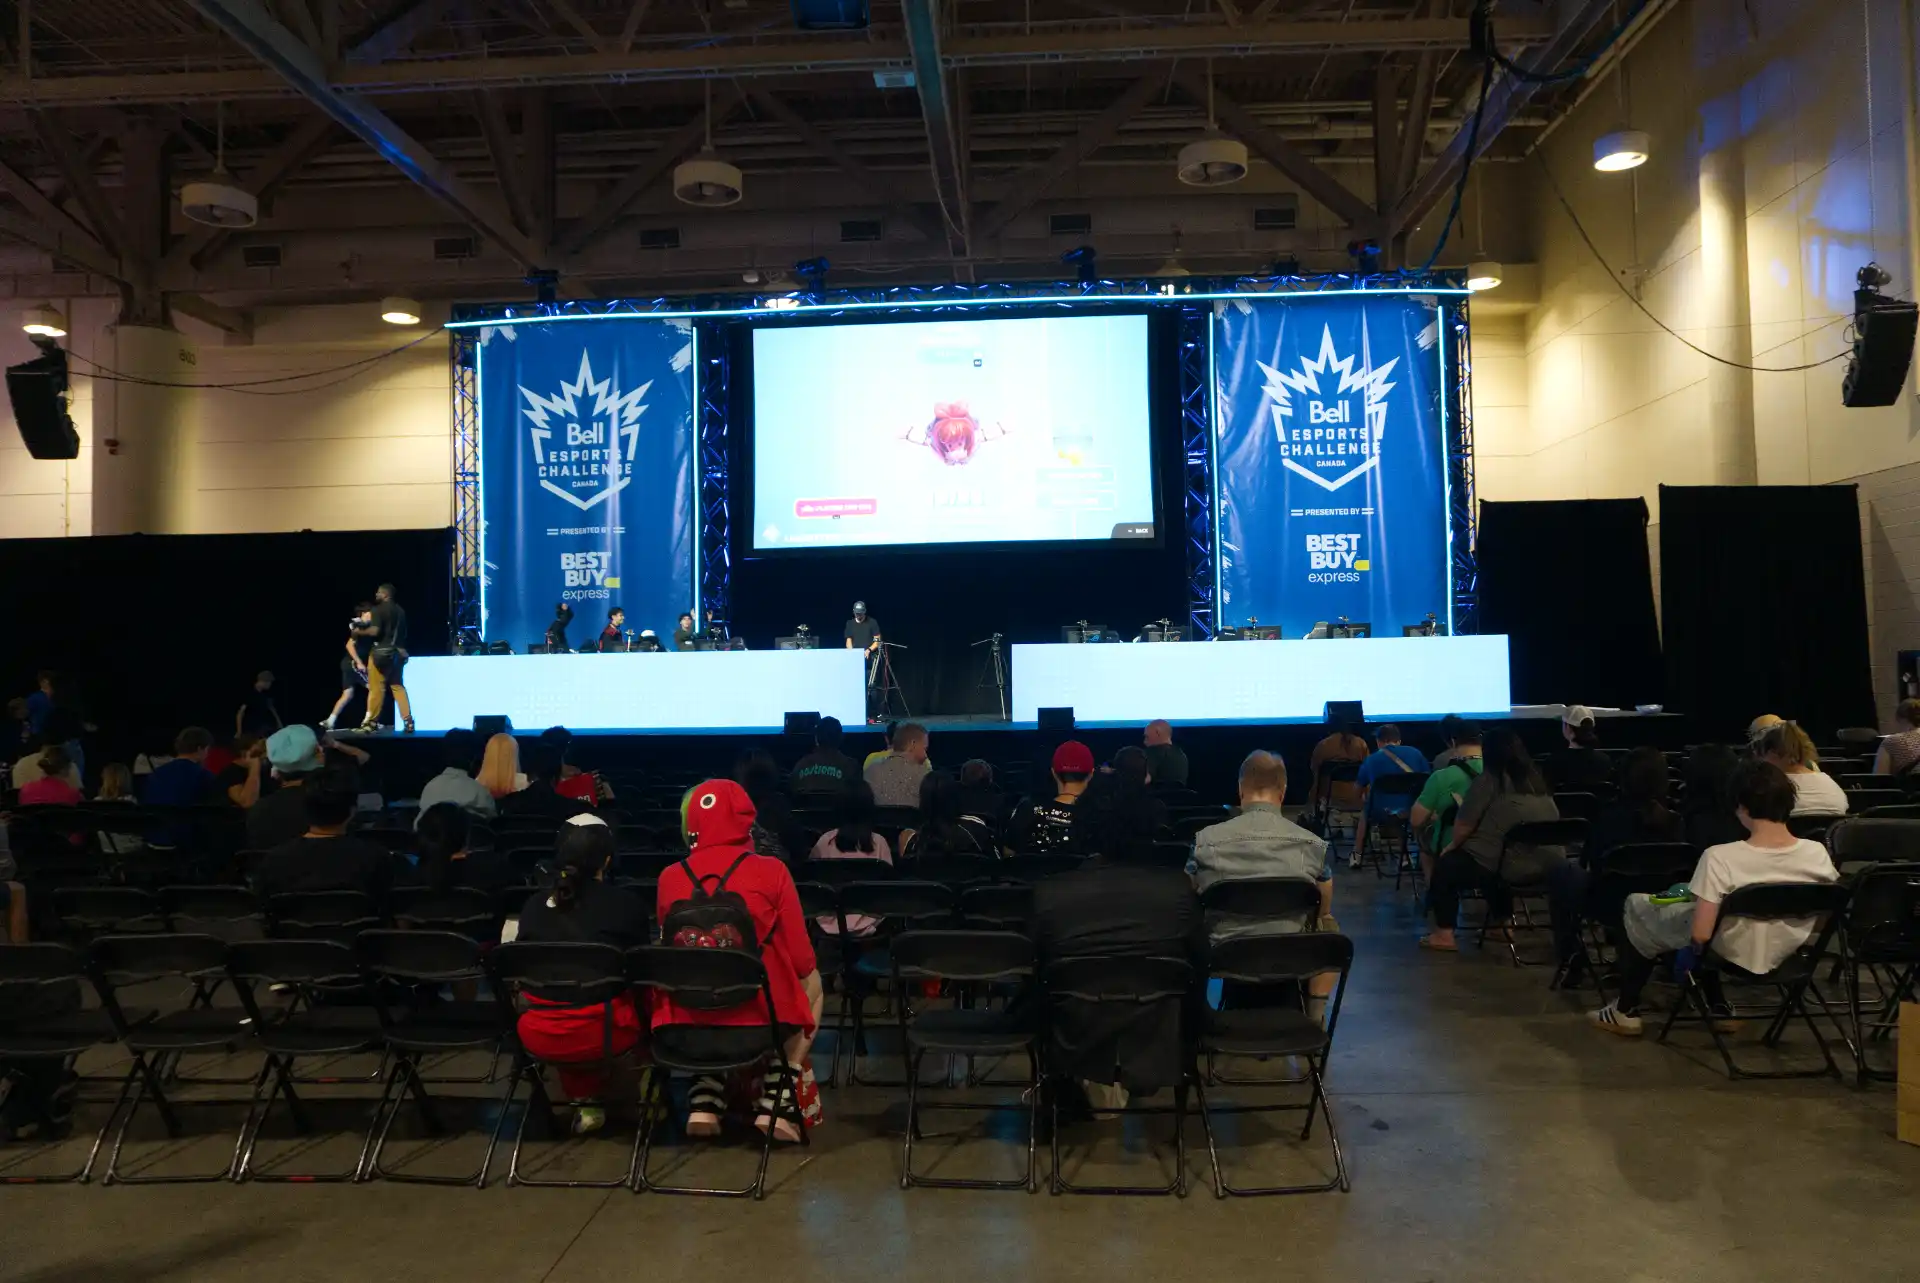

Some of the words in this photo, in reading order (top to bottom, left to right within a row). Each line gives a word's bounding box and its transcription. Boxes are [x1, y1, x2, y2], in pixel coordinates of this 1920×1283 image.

[1309, 400, 1350, 424] Bell
[567, 422, 604, 445] Bell
[1292, 428, 1368, 441] ESPORTS
[549, 449, 622, 462] ESPORTS
[1280, 442, 1381, 456] CHALLENGE
[538, 463, 632, 477] CHALLENGE
[572, 480, 598, 488] CANADA
[1305, 508, 1349, 516] PRESENTED
[560, 527, 600, 535] PRESENTED
[1306, 533, 1361, 552] BEST
[561, 552, 611, 570] BEST
[1311, 551, 1357, 569] BUY
[565, 568, 607, 586] BUY
[1308, 572, 1360, 585] express
[562, 589, 610, 602] express
